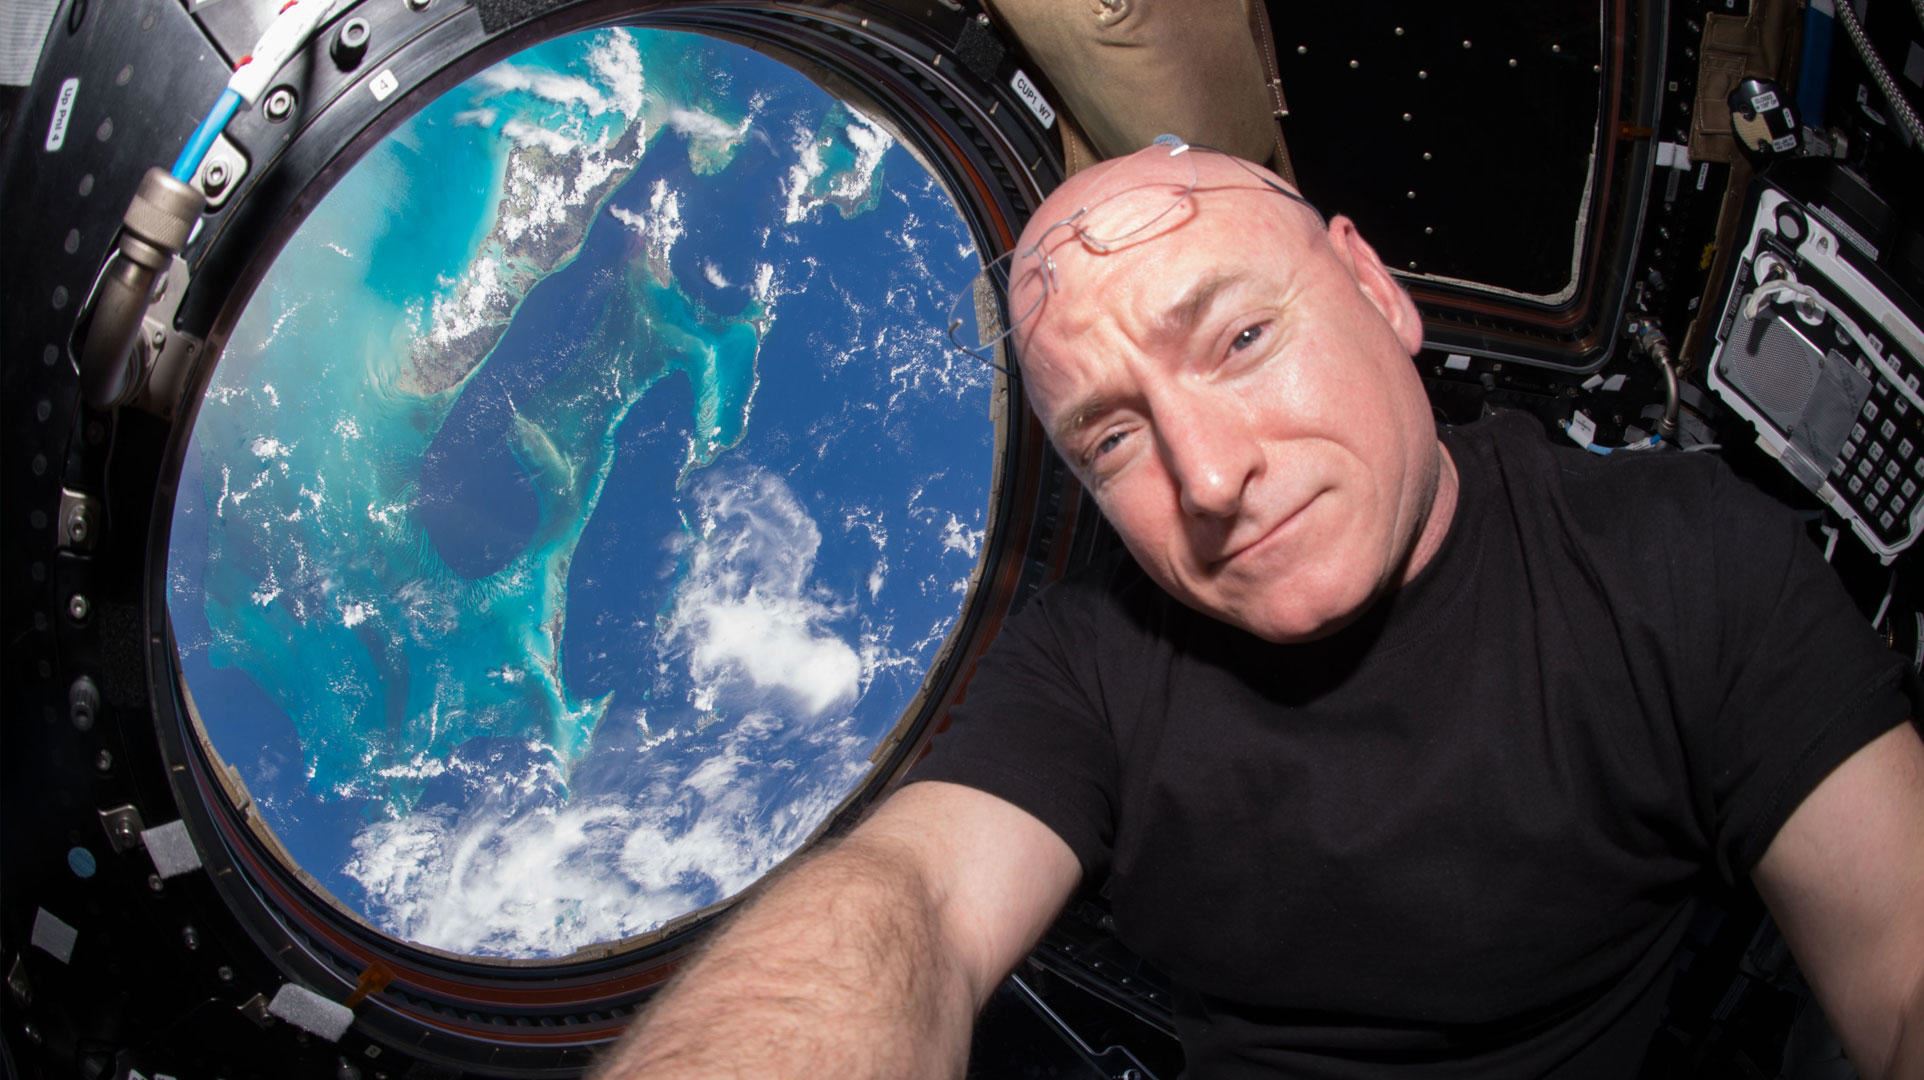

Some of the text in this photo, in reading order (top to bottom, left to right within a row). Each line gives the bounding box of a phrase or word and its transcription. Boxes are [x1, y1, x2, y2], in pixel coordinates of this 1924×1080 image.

[380, 79, 389, 90] 4
[1017, 78, 1051, 120] CUP1_W7
[52, 87, 73, 142] Up Pnl 4
